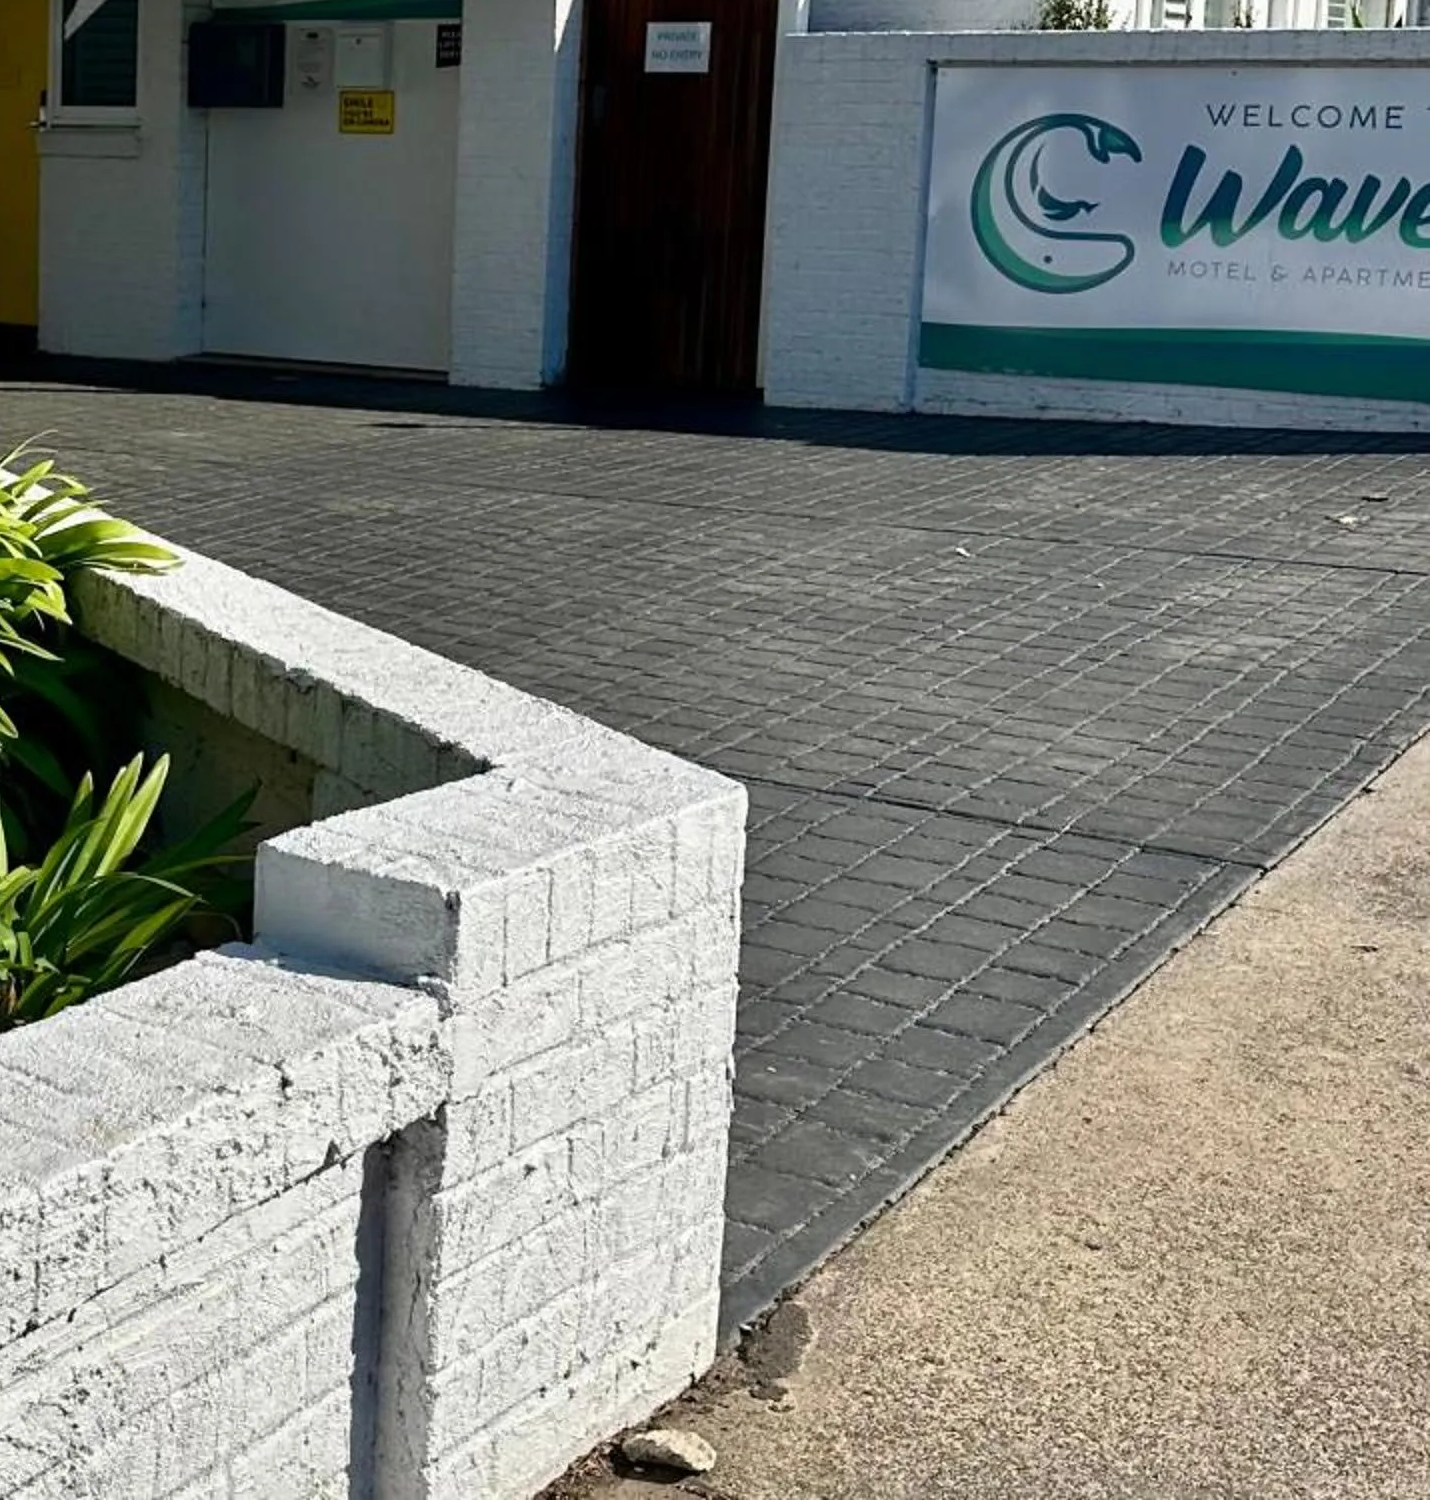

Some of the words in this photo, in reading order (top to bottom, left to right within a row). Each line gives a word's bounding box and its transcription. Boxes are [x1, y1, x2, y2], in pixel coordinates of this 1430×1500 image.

[652, 50, 668, 60] NO
[670, 50, 702, 60] ENTRY
[1206, 103, 1405, 130] WELCOME
[1168, 261, 1256, 282] MOTEL
[1271, 264, 1289, 283] &
